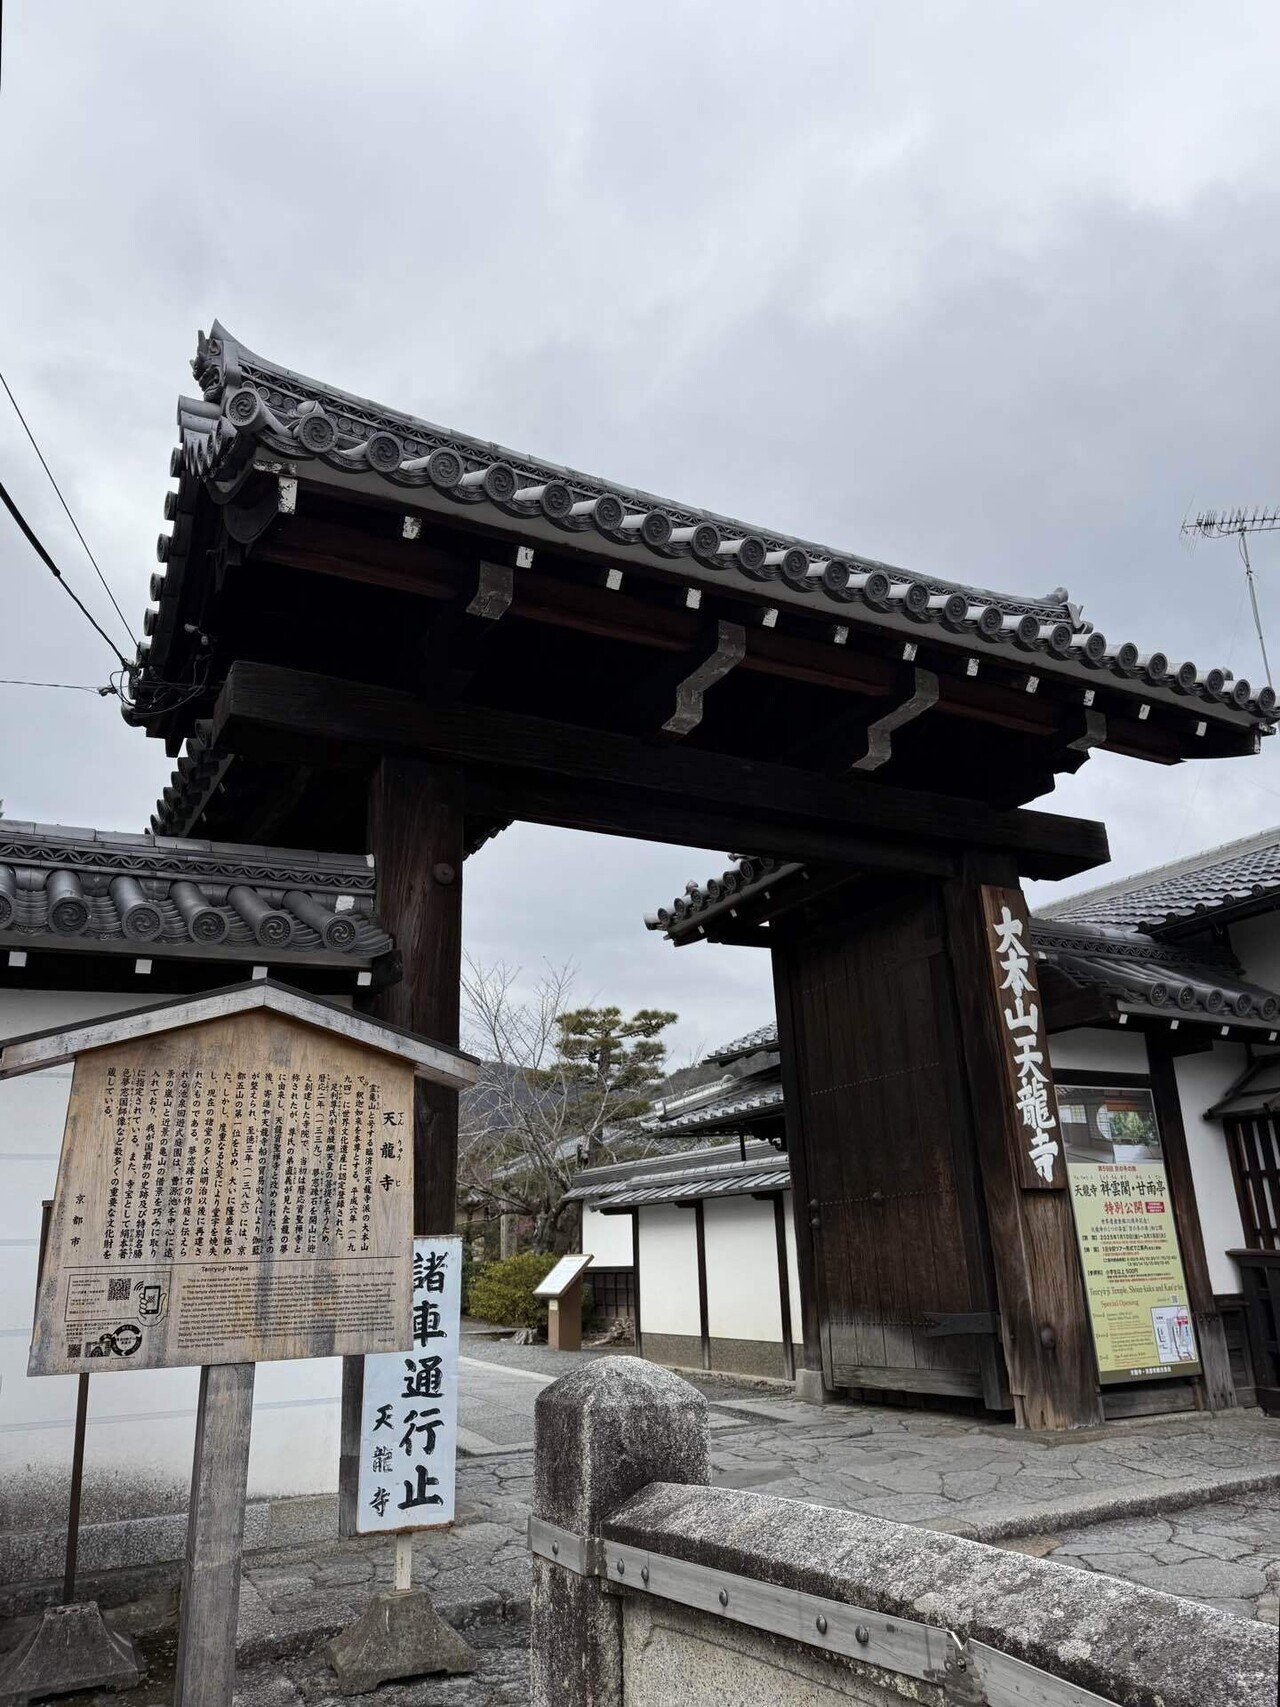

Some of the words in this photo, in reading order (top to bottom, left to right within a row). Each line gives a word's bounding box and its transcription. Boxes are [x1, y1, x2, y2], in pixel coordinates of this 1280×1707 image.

[993, 906, 1059, 1183] 大本山天龍寺
[380, 1112, 397, 1191] 天龍寺
[1074, 1184, 1098, 1197] 天龍寺
[71, 1194, 85, 1247] 京都市
[1104, 1200, 1144, 1215] 特別公開
[397, 1251, 448, 1511] 諸車通行止
[367, 1403, 394, 1517] 天龍寺
